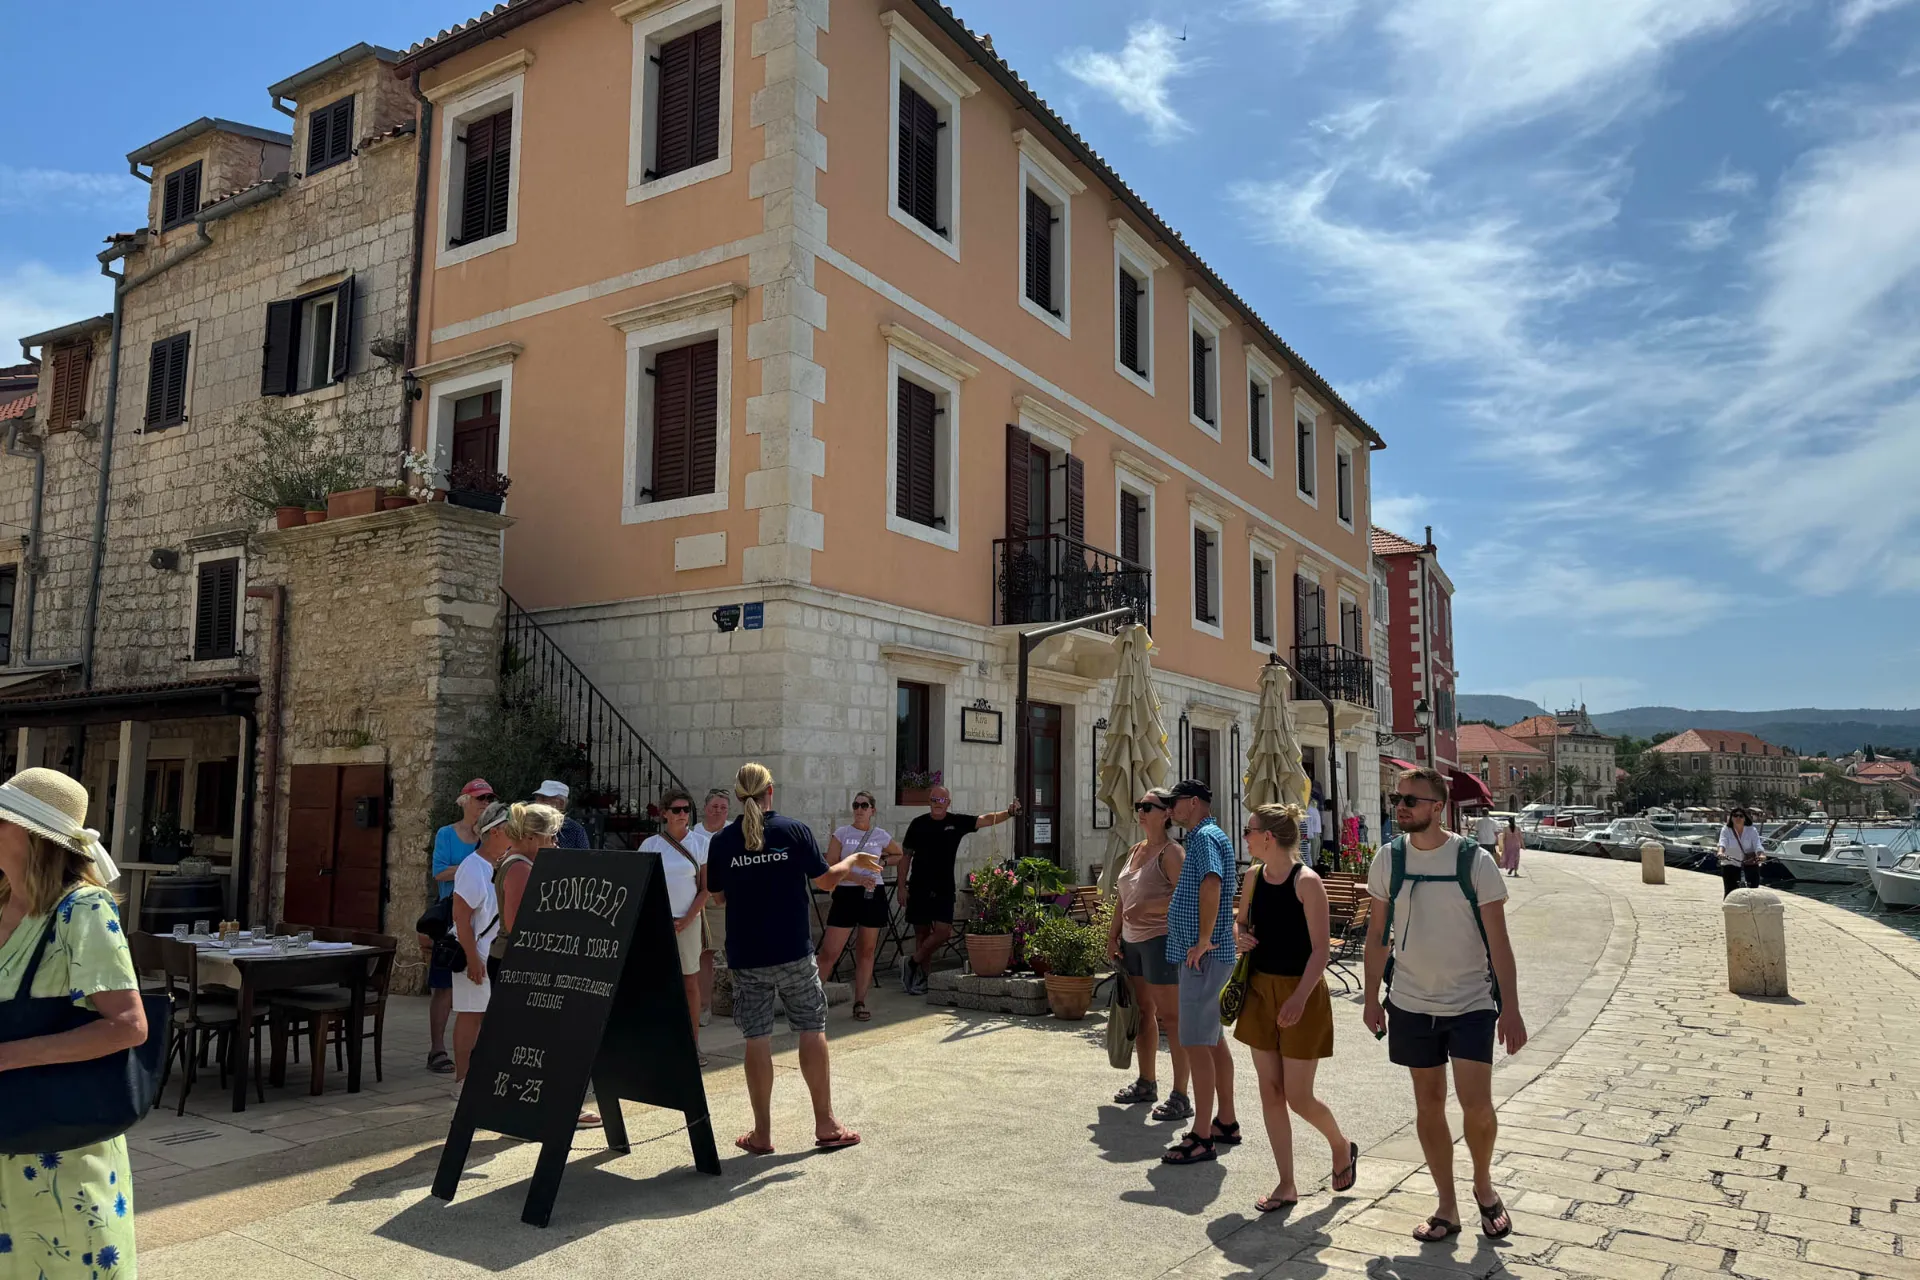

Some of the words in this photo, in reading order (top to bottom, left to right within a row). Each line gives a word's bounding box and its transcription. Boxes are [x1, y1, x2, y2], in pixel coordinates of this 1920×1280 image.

[730, 852, 789, 868] Albatros
[536, 877, 627, 927] KONOBA
[584, 938, 620, 959] MORA
[500, 969, 551, 987] TRADITIONAL
[526, 992, 565, 1010] CUISINE
[511, 1045, 545, 1069] OPEN
